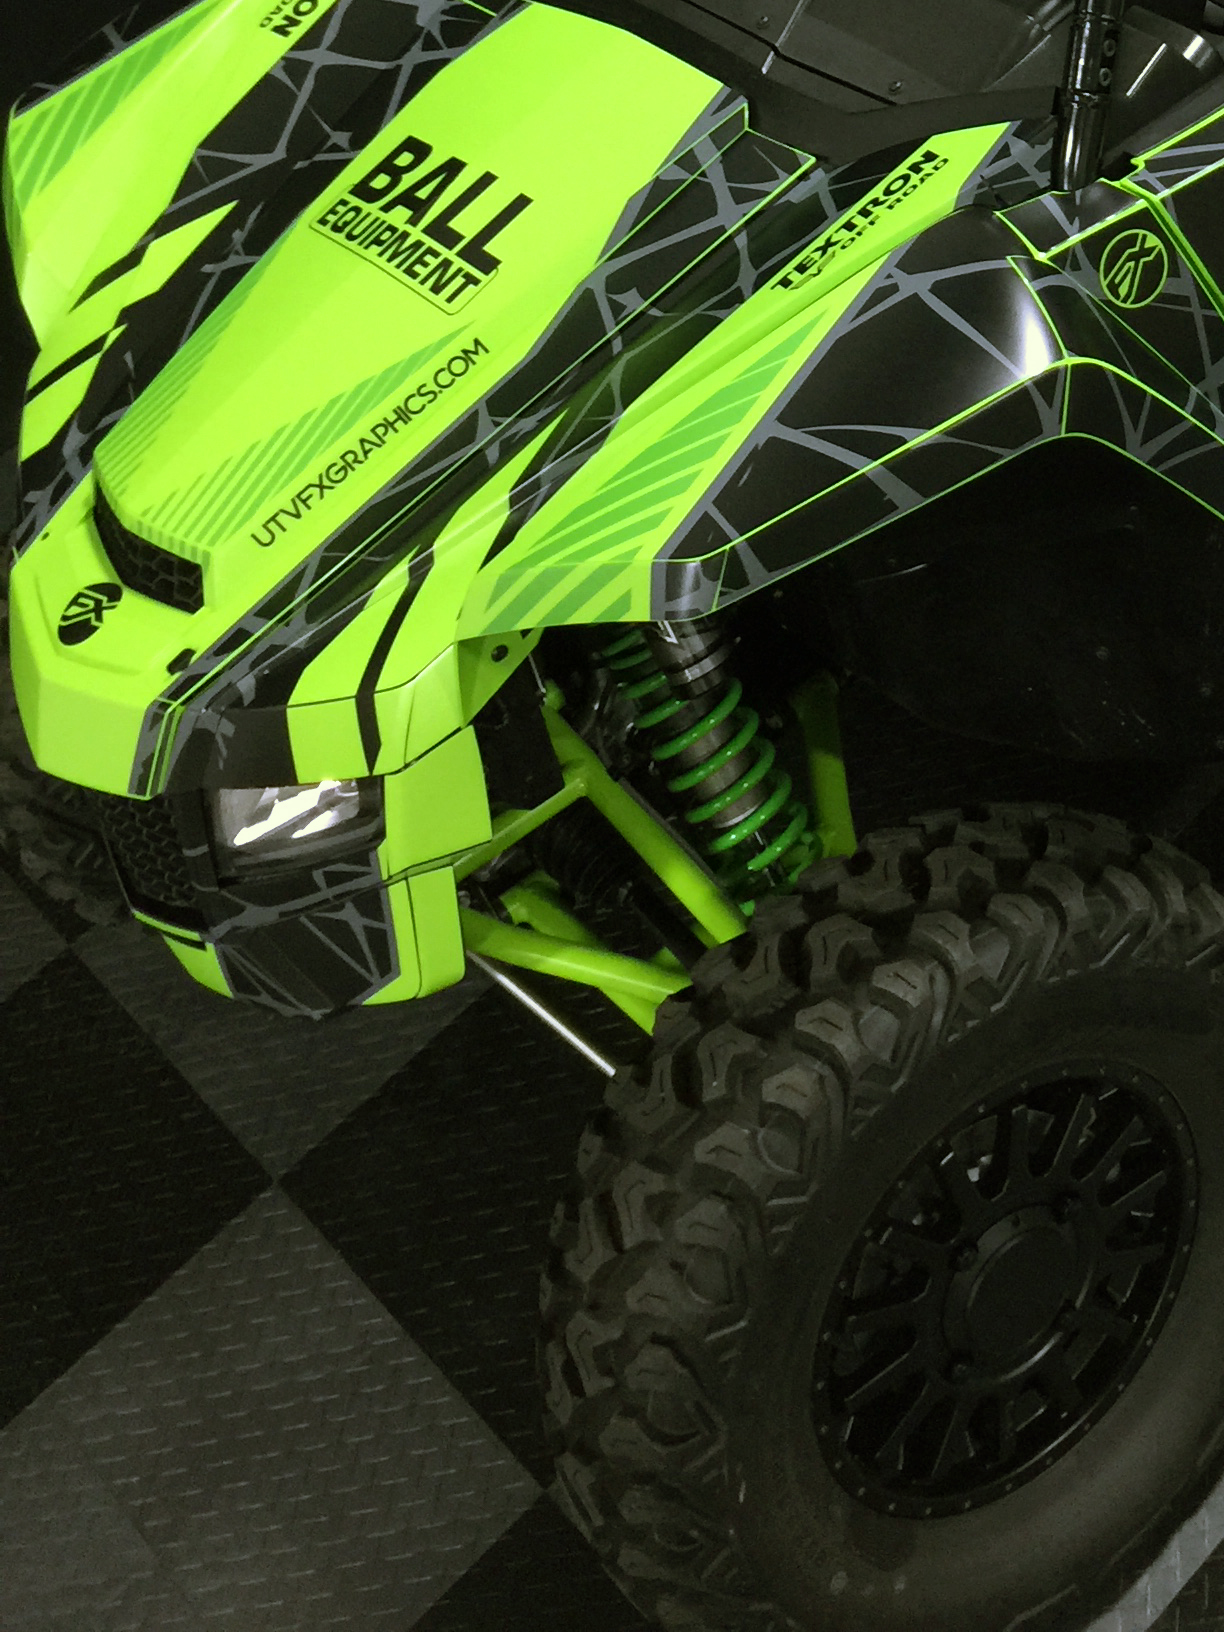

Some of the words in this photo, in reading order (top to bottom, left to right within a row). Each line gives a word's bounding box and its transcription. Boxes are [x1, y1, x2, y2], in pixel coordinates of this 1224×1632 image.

[316, 198, 482, 304] EQUIPMENT
[348, 135, 534, 276] BALL
[770, 150, 940, 290] TEXTRON
[840, 214, 881, 250] OFF
[886, 158, 949, 210] ROAD
[250, 337, 490, 548] UTVFXGRAPHICS.COM
